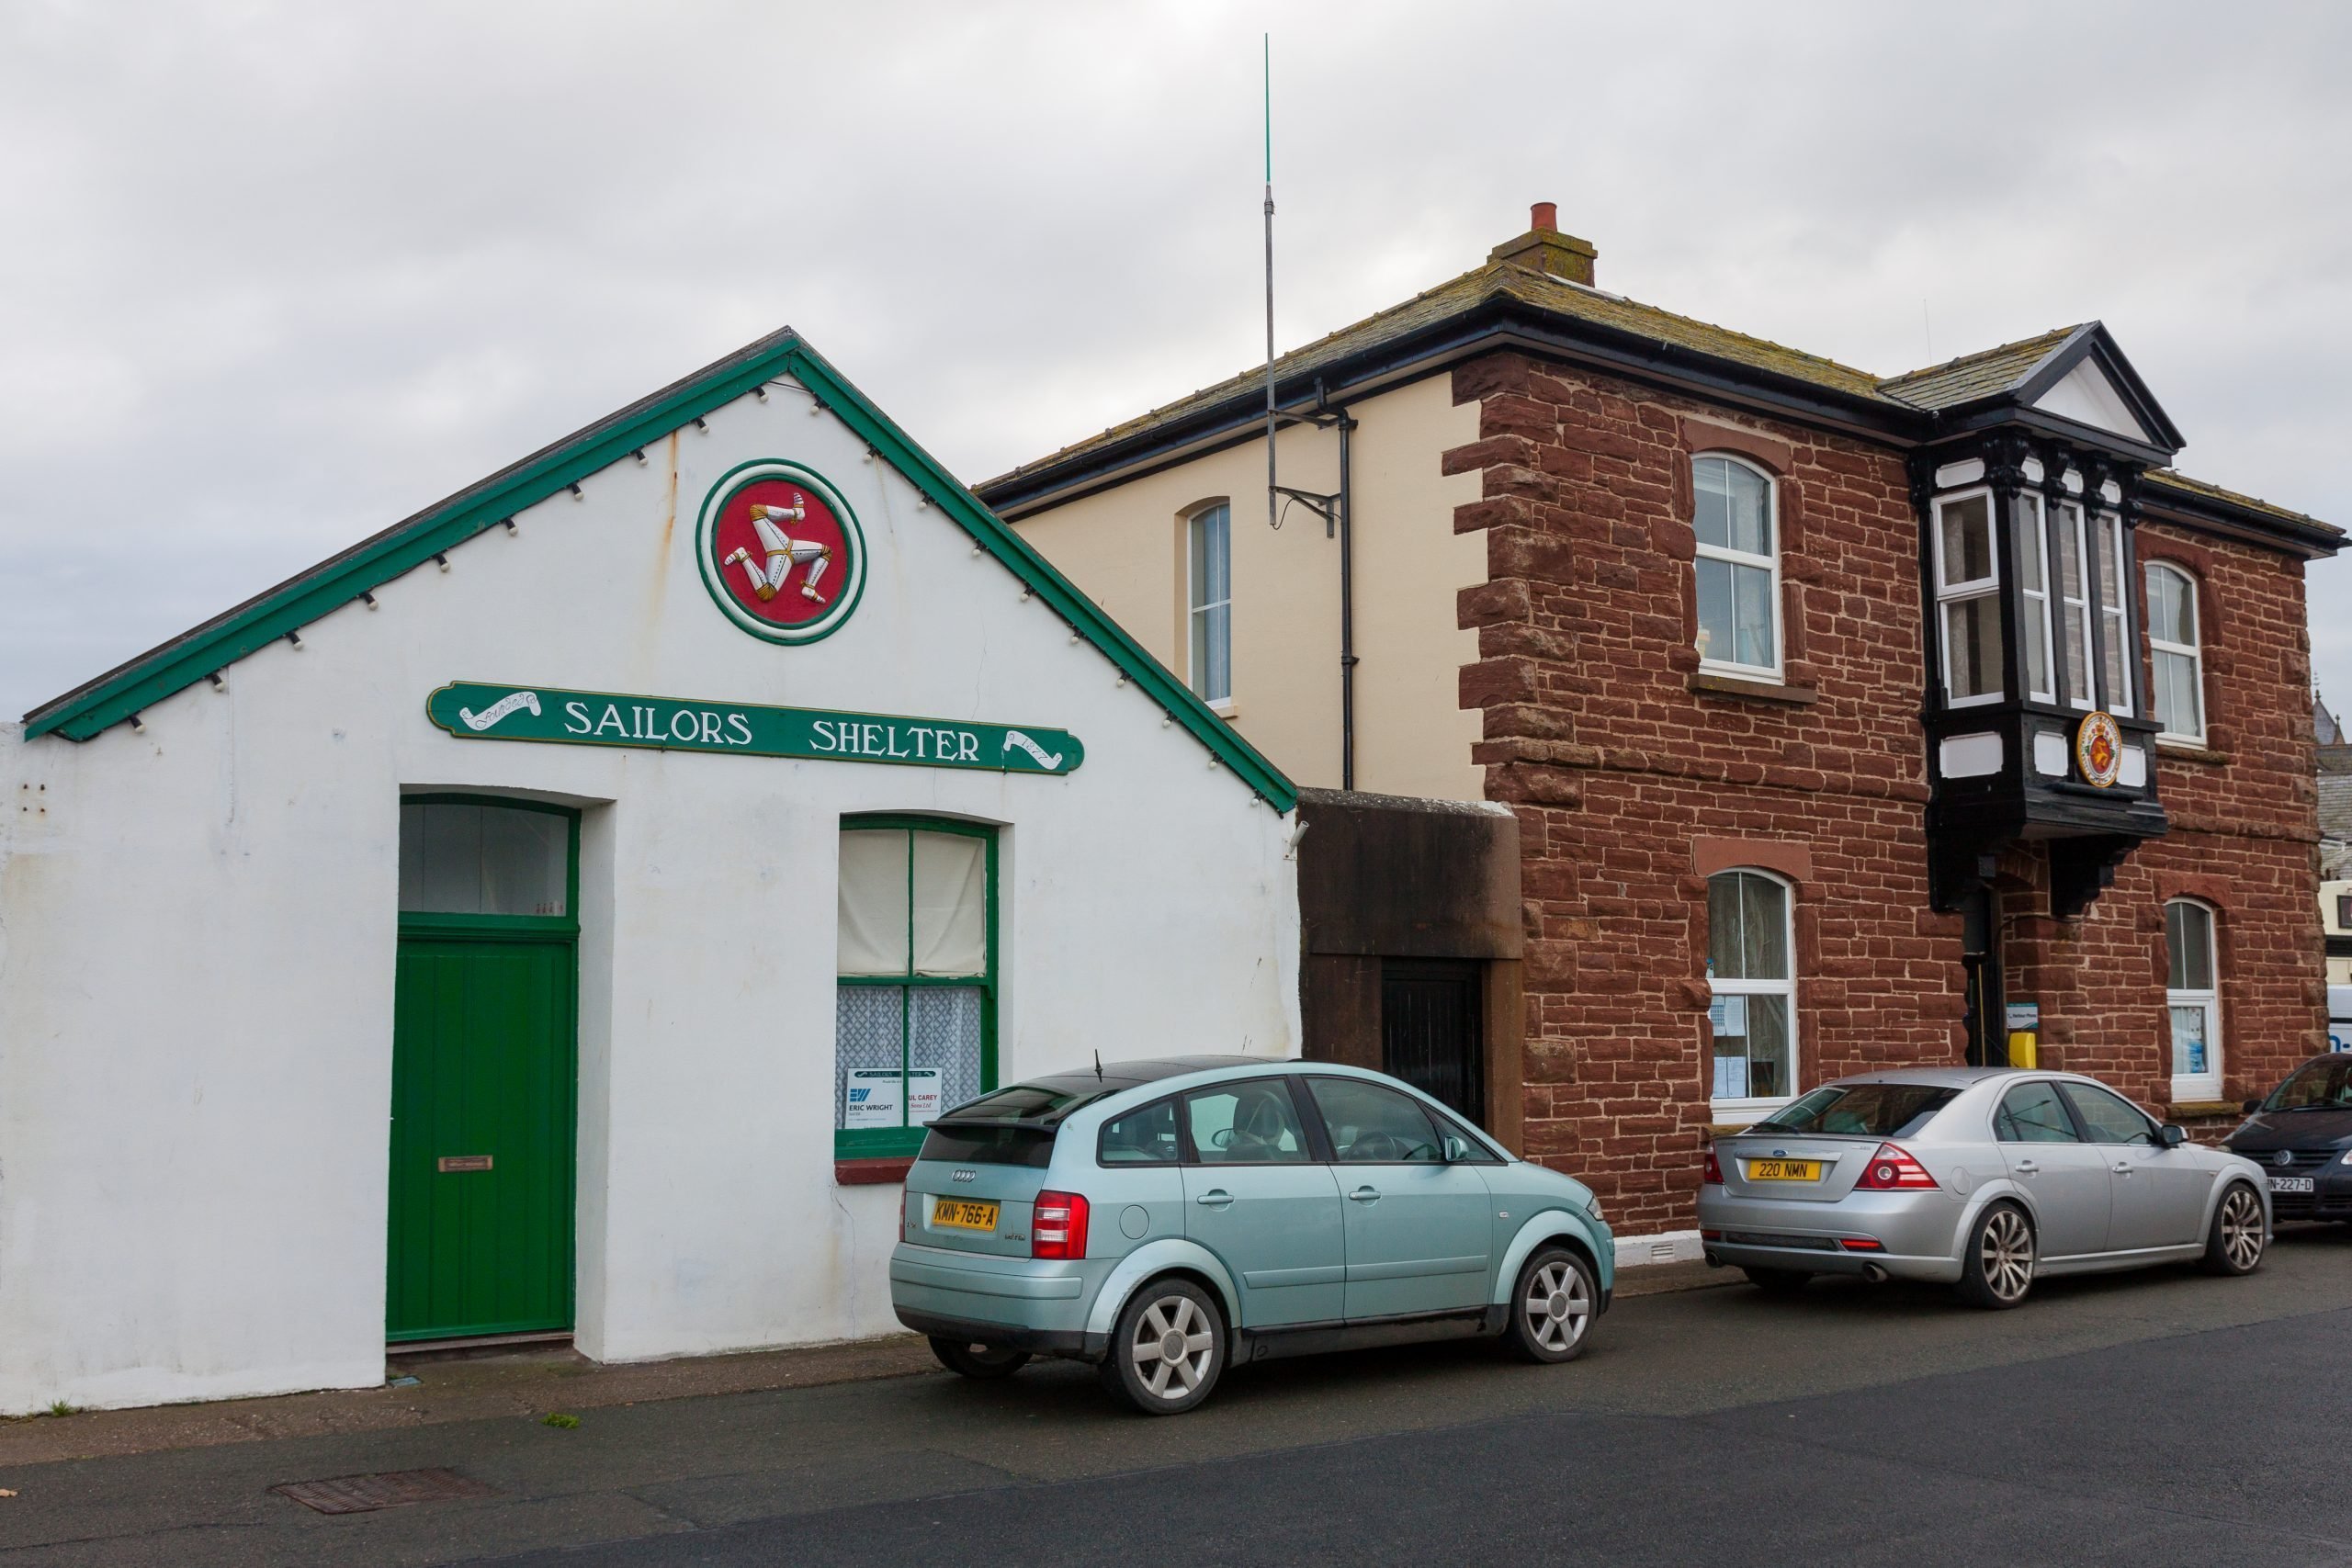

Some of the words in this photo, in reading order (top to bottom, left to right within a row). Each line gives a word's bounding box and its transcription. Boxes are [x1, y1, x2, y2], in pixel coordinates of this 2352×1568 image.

[563, 701, 753, 746] SAILORS
[808, 720, 980, 761] SHELTER
[865, 1103, 893, 1111] WRIGHT
[1758, 1163, 1781, 1178] 220
[1784, 1163, 1808, 1178] NMN
[2267, 1178, 2312, 1191] N-227-D
[934, 1201, 995, 1227] KMN-766-A
